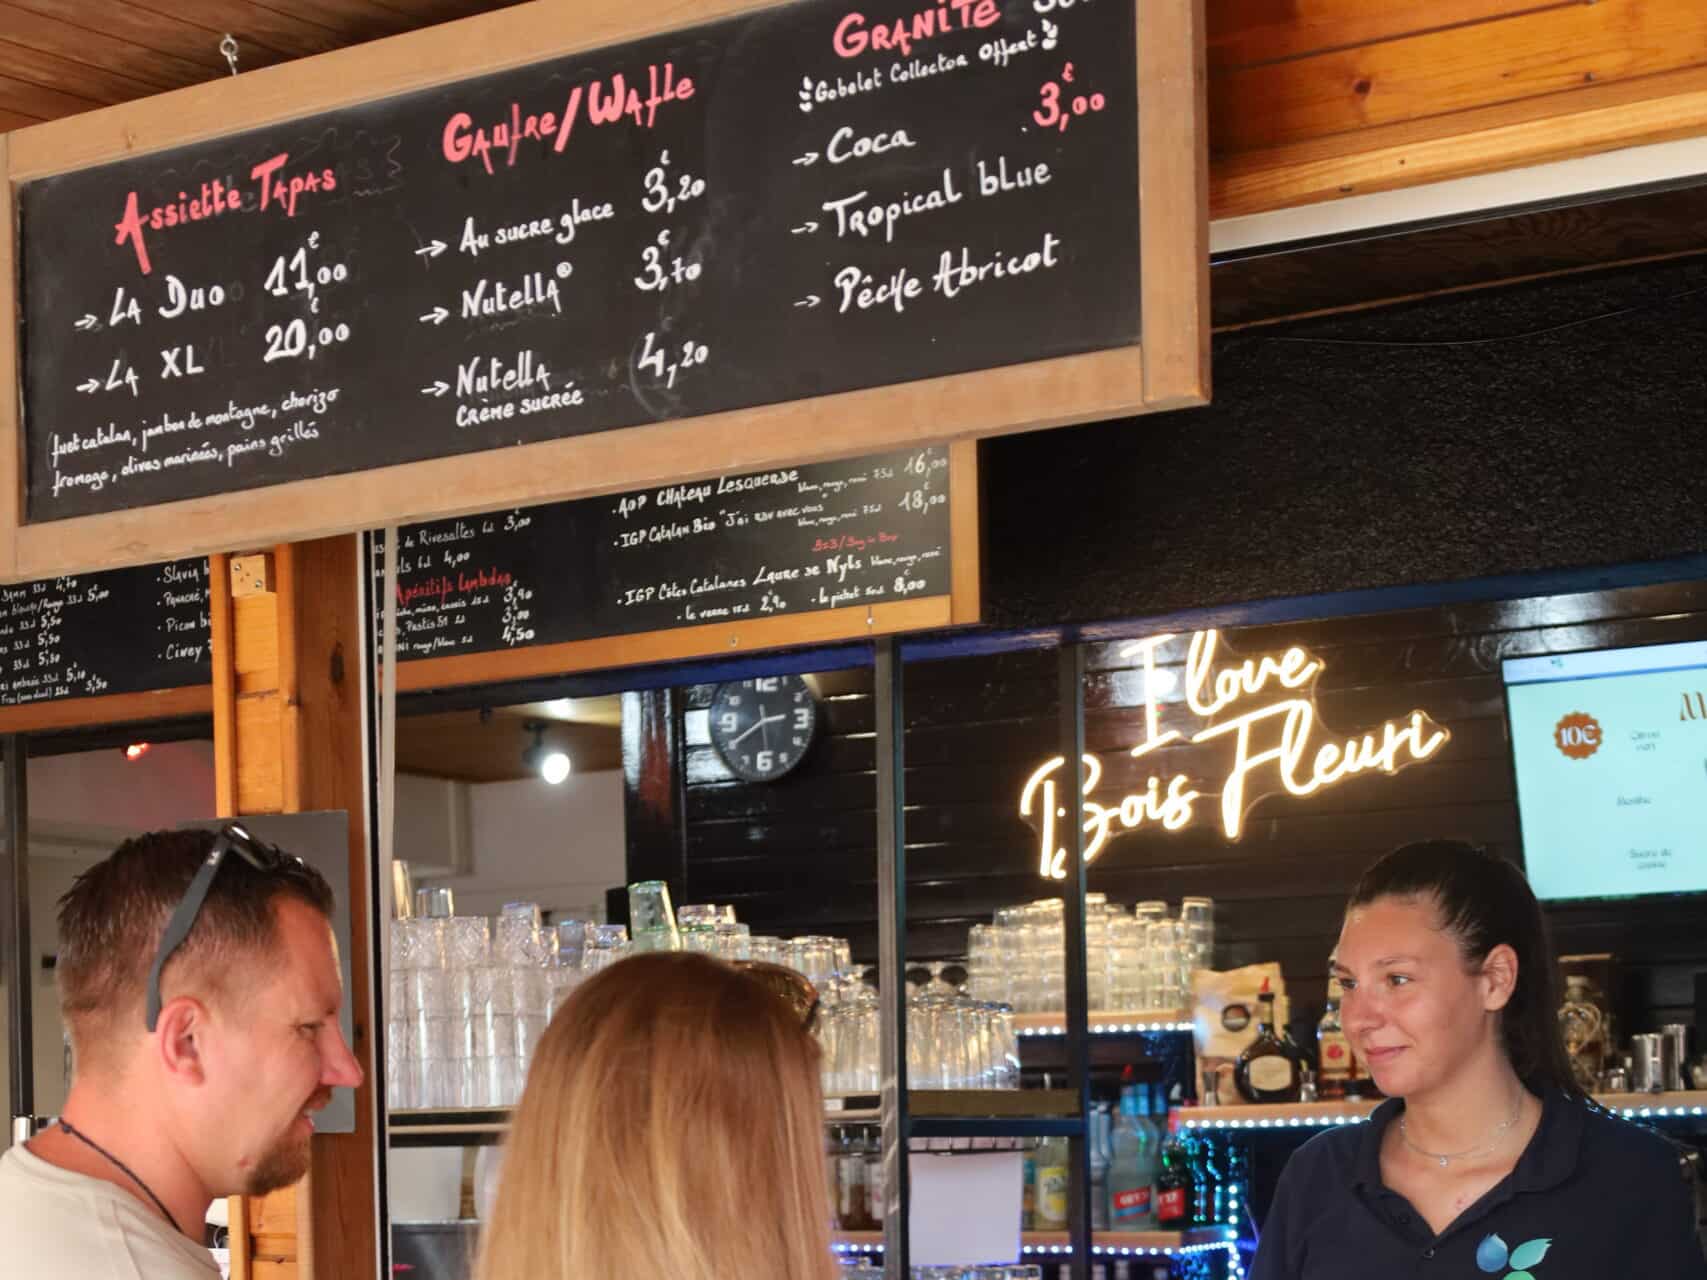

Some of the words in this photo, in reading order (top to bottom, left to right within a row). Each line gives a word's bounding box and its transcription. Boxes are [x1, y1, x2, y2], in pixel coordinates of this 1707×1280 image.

[815, 68, 882, 102] Gobelet
[826, 126, 916, 164] Coca
[822, 168, 963, 242] Tropical
[978, 156, 1051, 196] blue
[459, 217, 488, 256] Au
[555, 199, 615, 245] glace
[933, 233, 1060, 297] Abricot
[159, 274, 226, 319] Duo
[161, 345, 205, 379] XL
[456, 350, 552, 398] Nutella
[1121, 634, 1183, 757] I
[1184, 629, 1320, 716] love
[721, 711, 738, 733] 9
[793, 708, 810, 730] 3
[1561, 724, 1597, 747] 10€
[756, 751, 773, 771] 6
[1020, 752, 1199, 879] Bois
[1192, 699, 1447, 839] Fleuri
